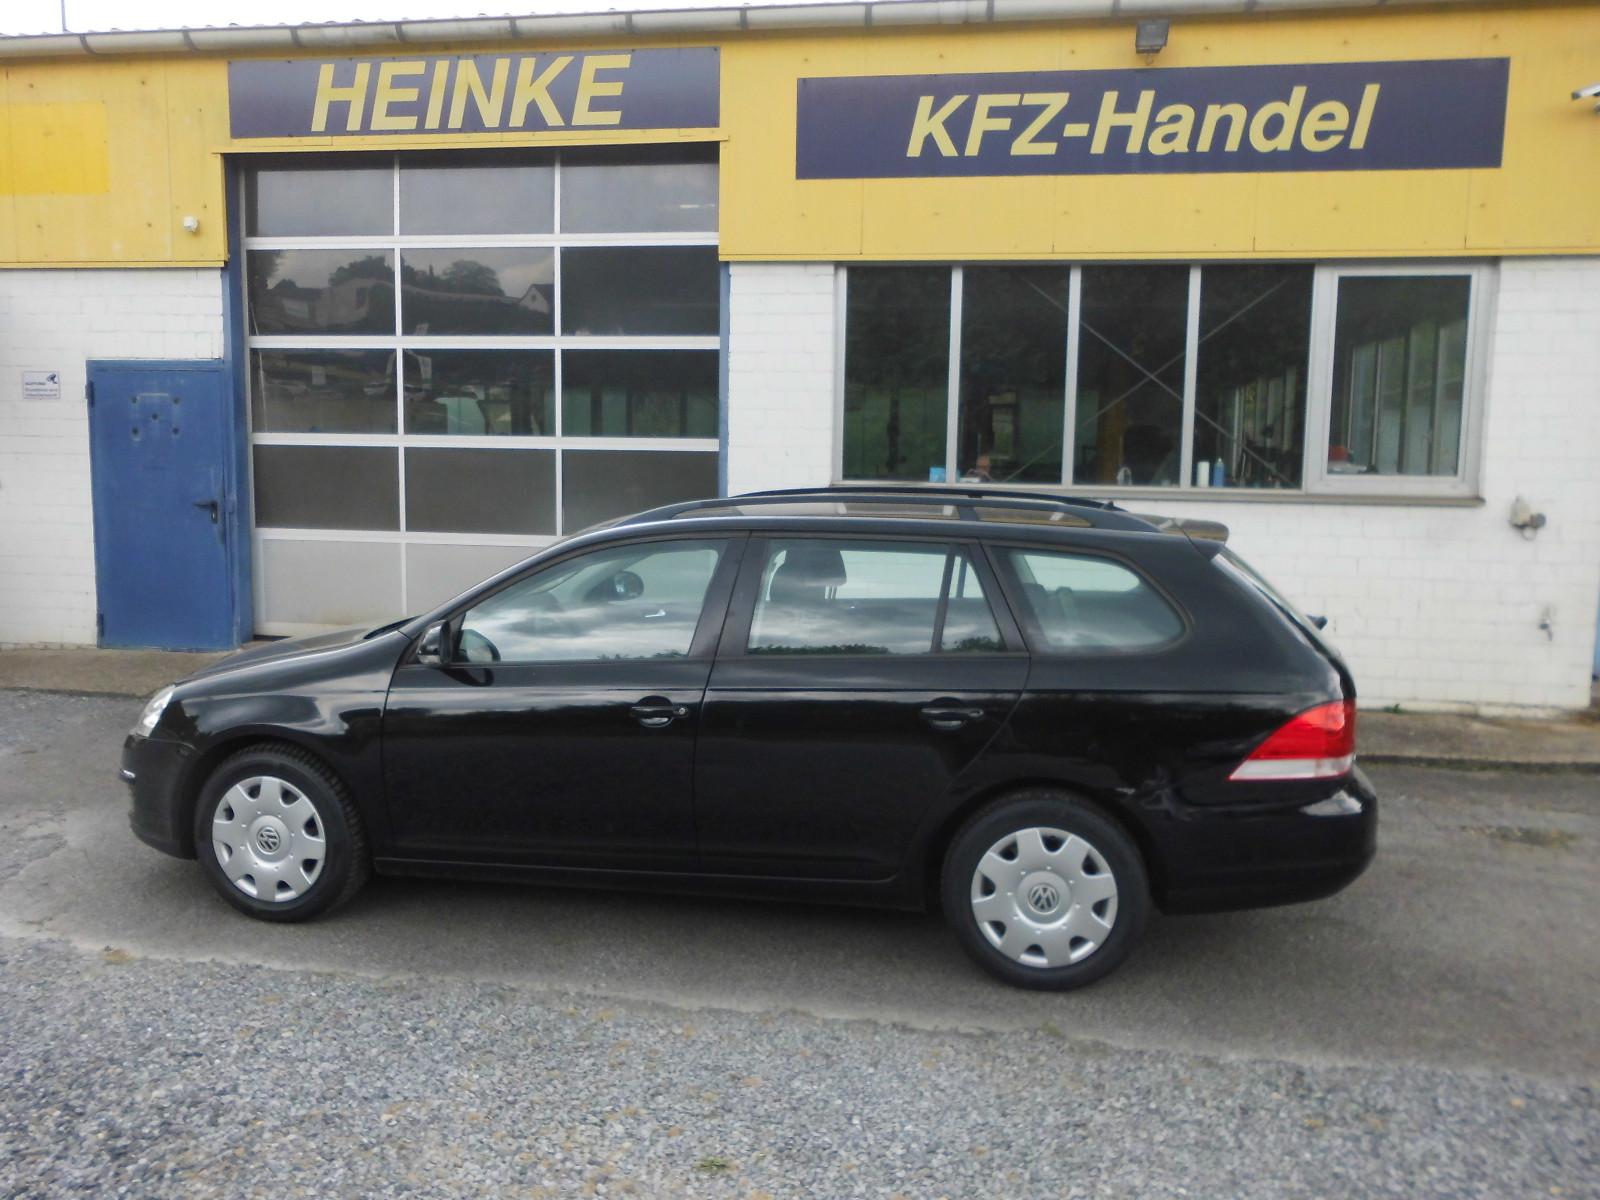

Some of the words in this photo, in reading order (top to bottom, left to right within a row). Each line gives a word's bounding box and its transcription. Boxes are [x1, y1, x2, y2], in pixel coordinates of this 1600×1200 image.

[310, 53, 632, 133] HEINKE
[906, 82, 1381, 158] KFZ-Handel
[257, 827, 280, 853] VW
[1029, 884, 1059, 913] VW
